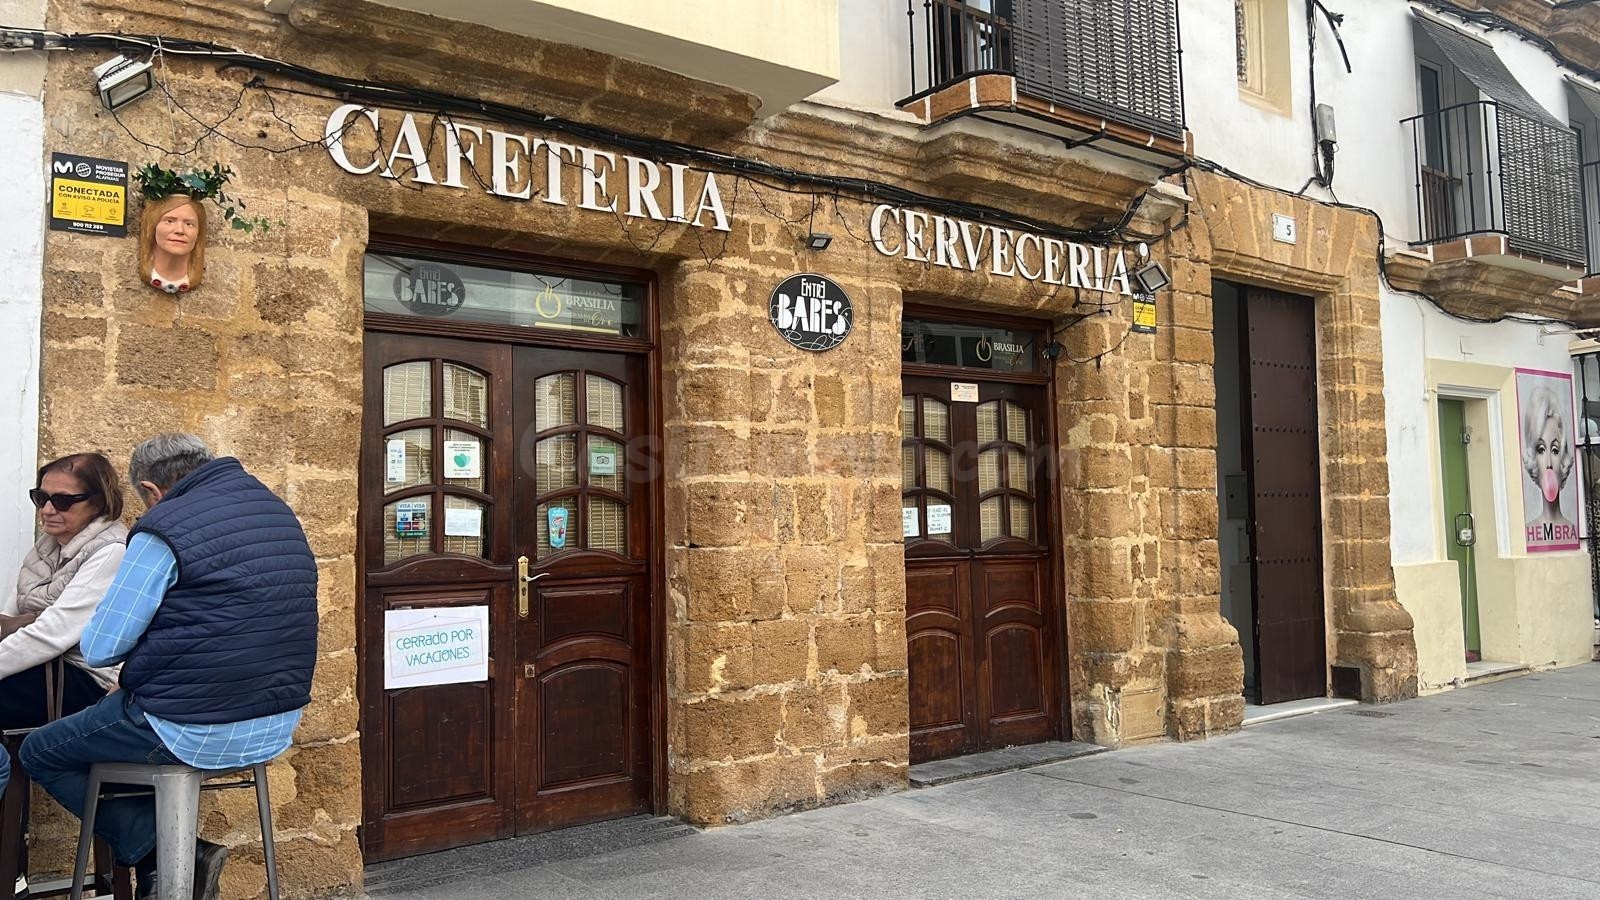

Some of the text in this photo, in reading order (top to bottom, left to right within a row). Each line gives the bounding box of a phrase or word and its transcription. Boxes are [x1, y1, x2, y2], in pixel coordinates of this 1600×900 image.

[325, 103, 732, 232] CAFETERIA
[58, 185, 120, 199] CONECTADA
[1286, 225, 1292, 236] 5
[869, 203, 1134, 297] CERVECERIA
[400, 276, 459, 307] BARES
[566, 295, 616, 311] BRASILIA
[778, 293, 847, 336] BARES
[993, 342, 1024, 354] BRASILIA
[1526, 522, 1578, 542] HEMBRA
[451, 628, 474, 643] POR
[405, 646, 470, 667] VACACIONES
